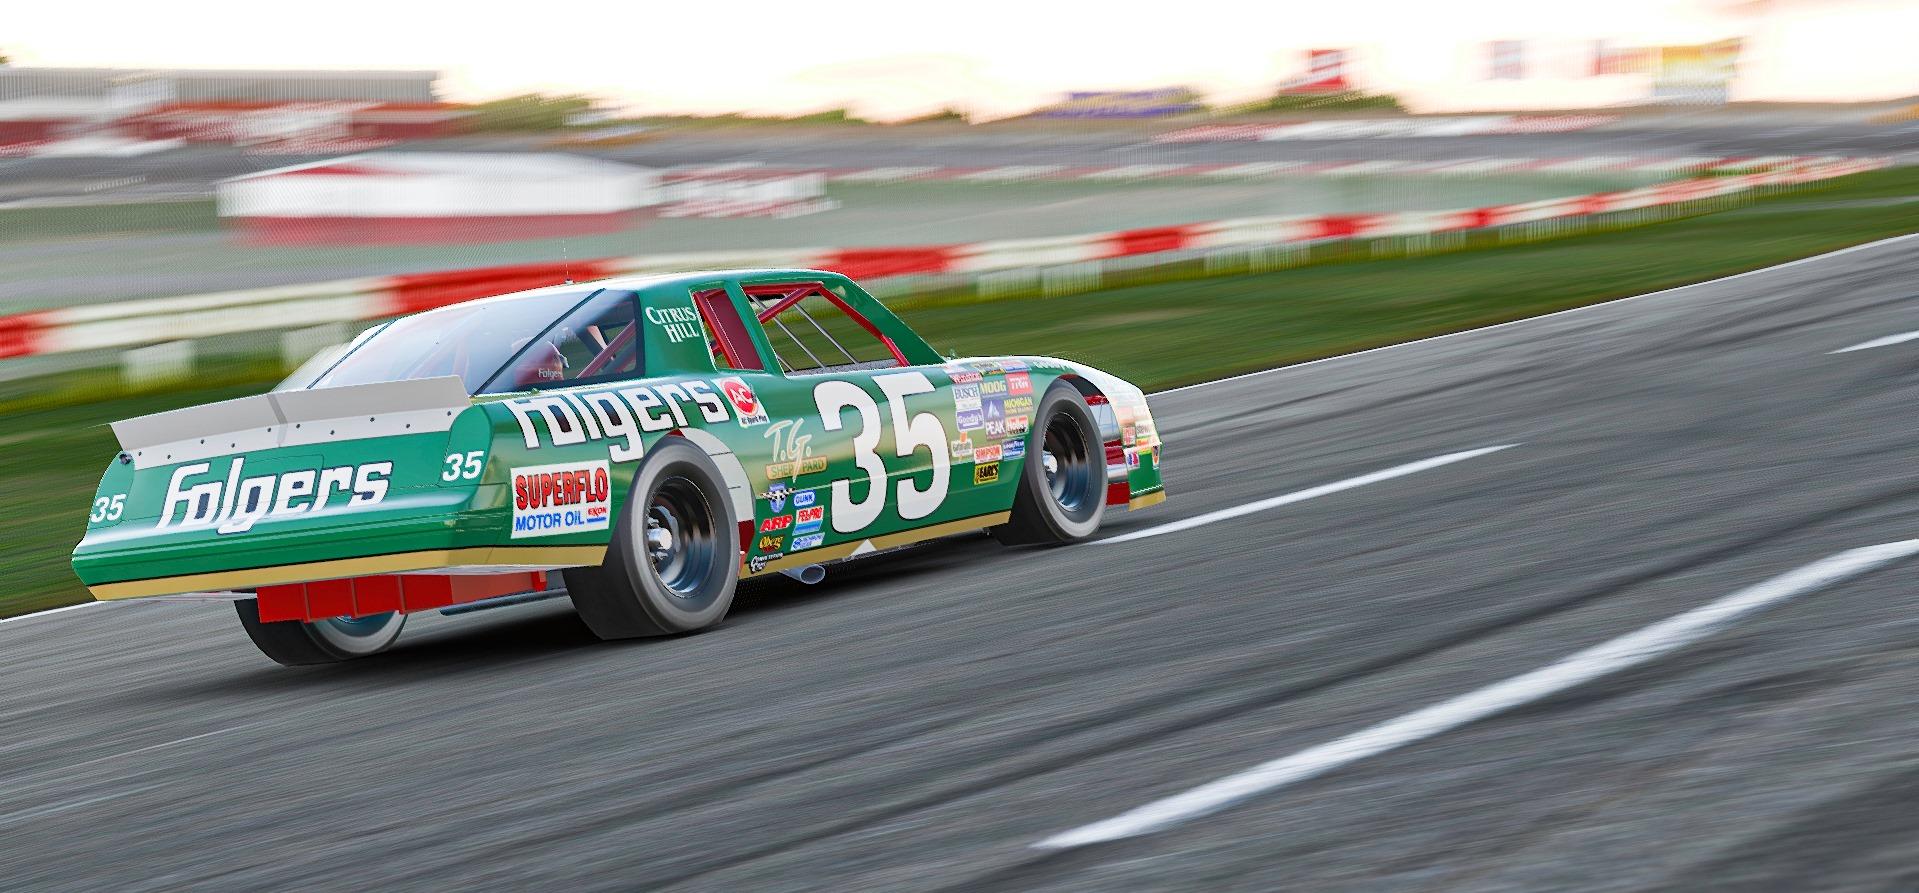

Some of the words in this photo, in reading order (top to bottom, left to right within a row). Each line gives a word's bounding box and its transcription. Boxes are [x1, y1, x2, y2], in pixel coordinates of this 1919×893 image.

[646, 306, 696, 325] CITRUS
[664, 322, 700, 343] HILL
[729, 387, 754, 404] AC
[955, 387, 979, 400] BUSCH
[981, 381, 1006, 394] MOOG
[503, 380, 730, 463] Folgers
[986, 420, 1006, 435] PEAK
[813, 371, 950, 533] 35
[975, 446, 1000, 458] SIMPSON
[442, 450, 484, 482] 35
[156, 457, 394, 536] Folgers
[515, 467, 609, 511] SUPERFLO
[795, 493, 814, 505] GUNK
[91, 494, 127, 524] 35
[515, 512, 562, 532] MOTOR
[564, 510, 585, 527] OIL
[759, 514, 794, 533] ARP
